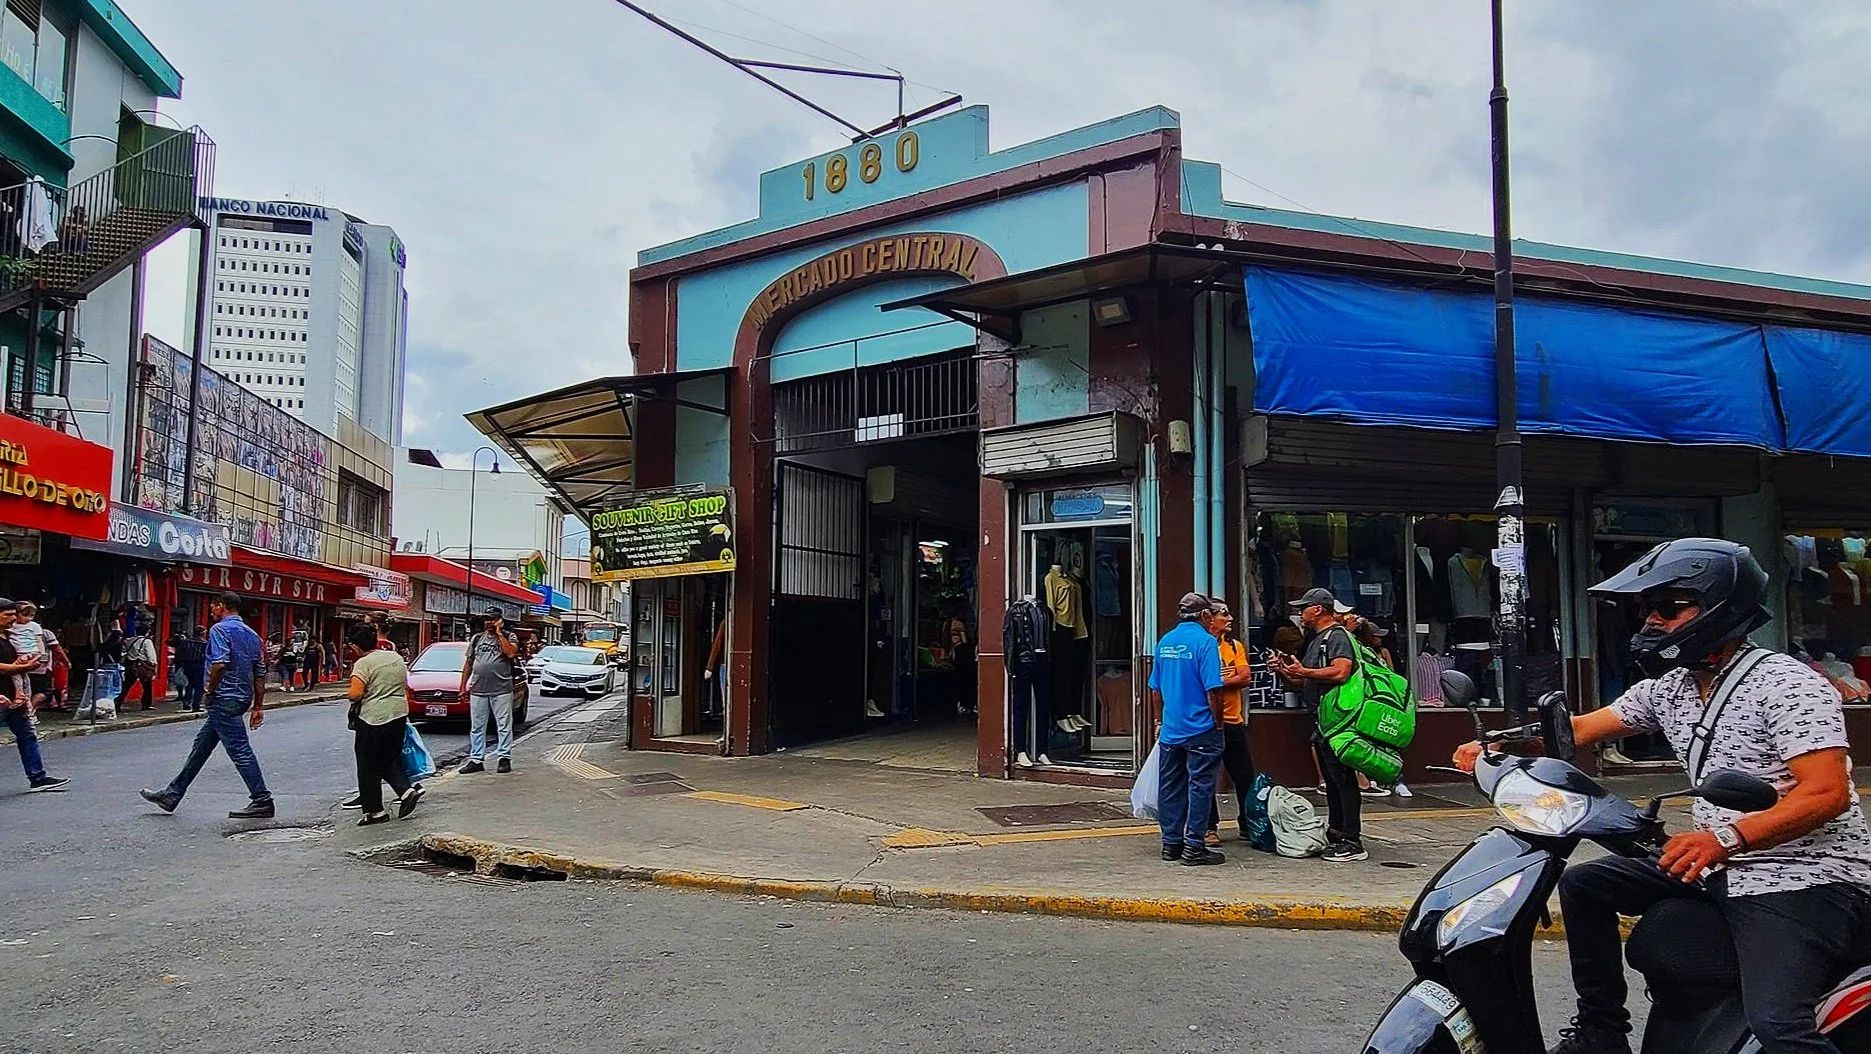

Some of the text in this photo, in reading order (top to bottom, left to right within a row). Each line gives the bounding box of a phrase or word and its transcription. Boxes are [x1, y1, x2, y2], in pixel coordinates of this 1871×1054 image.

[803, 131, 919, 201] 1880
[256, 201, 330, 221] NACIONAL
[749, 234, 980, 331] MERCADO CENTRAL
[44, 479, 68, 506] DE
[73, 488, 107, 514] ORO
[593, 506, 655, 531] SOUVENIR
[689, 496, 727, 518] SHOP
[244, 570, 281, 595] SYR
[293, 579, 324, 601] SYR
[1377, 721, 1399, 737] Eats
[1381, 712, 1401, 727] Uber
